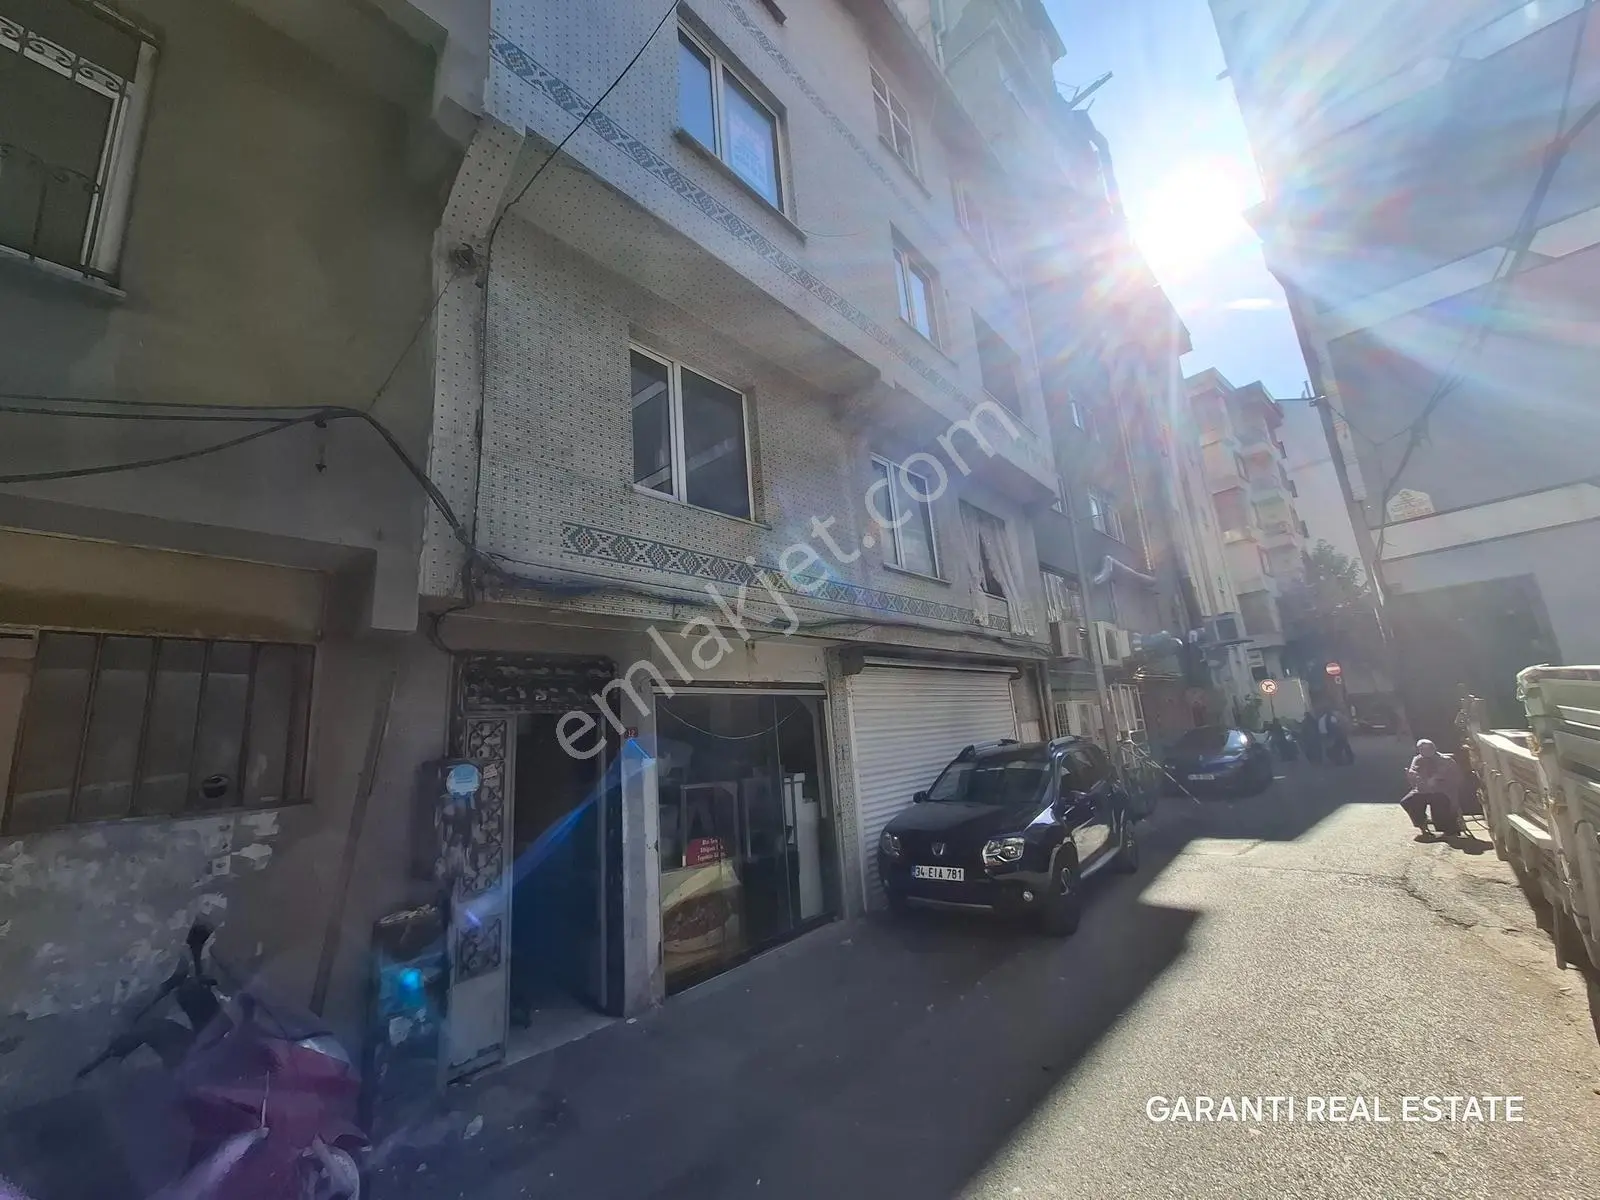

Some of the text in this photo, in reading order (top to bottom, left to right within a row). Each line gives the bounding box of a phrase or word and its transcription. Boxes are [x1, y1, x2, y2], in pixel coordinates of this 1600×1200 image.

[915, 867, 962, 879] 34 EIA 781
